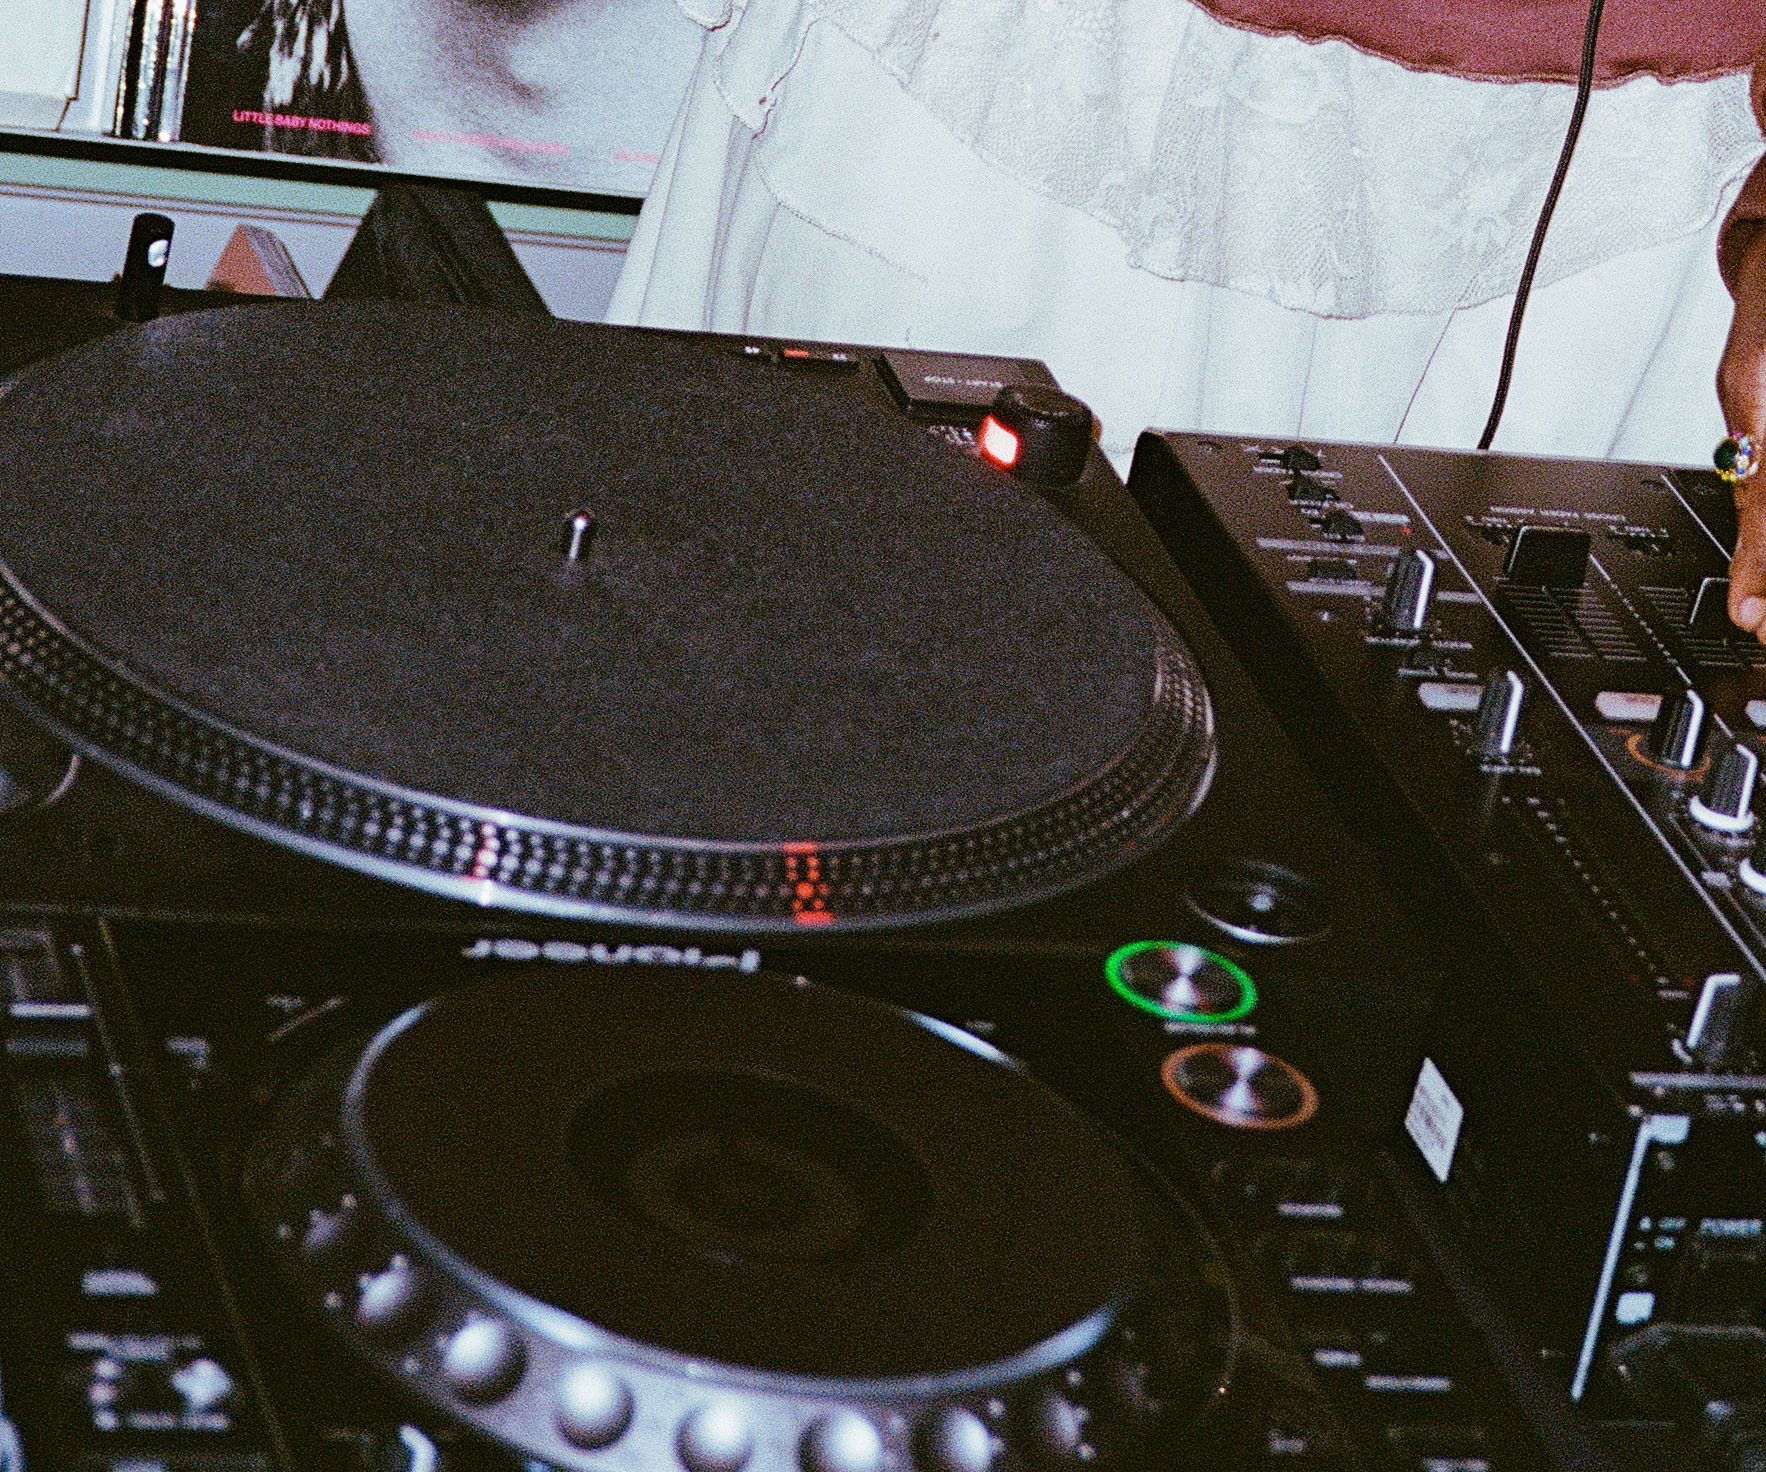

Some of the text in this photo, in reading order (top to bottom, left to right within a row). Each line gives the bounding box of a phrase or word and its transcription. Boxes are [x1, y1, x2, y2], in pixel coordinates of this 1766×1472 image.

[231, 109, 373, 137] LITTLE BABY NOTHINGS
[463, 939, 761, 974] Pioneer
[1700, 1218, 1764, 1237] POWER
